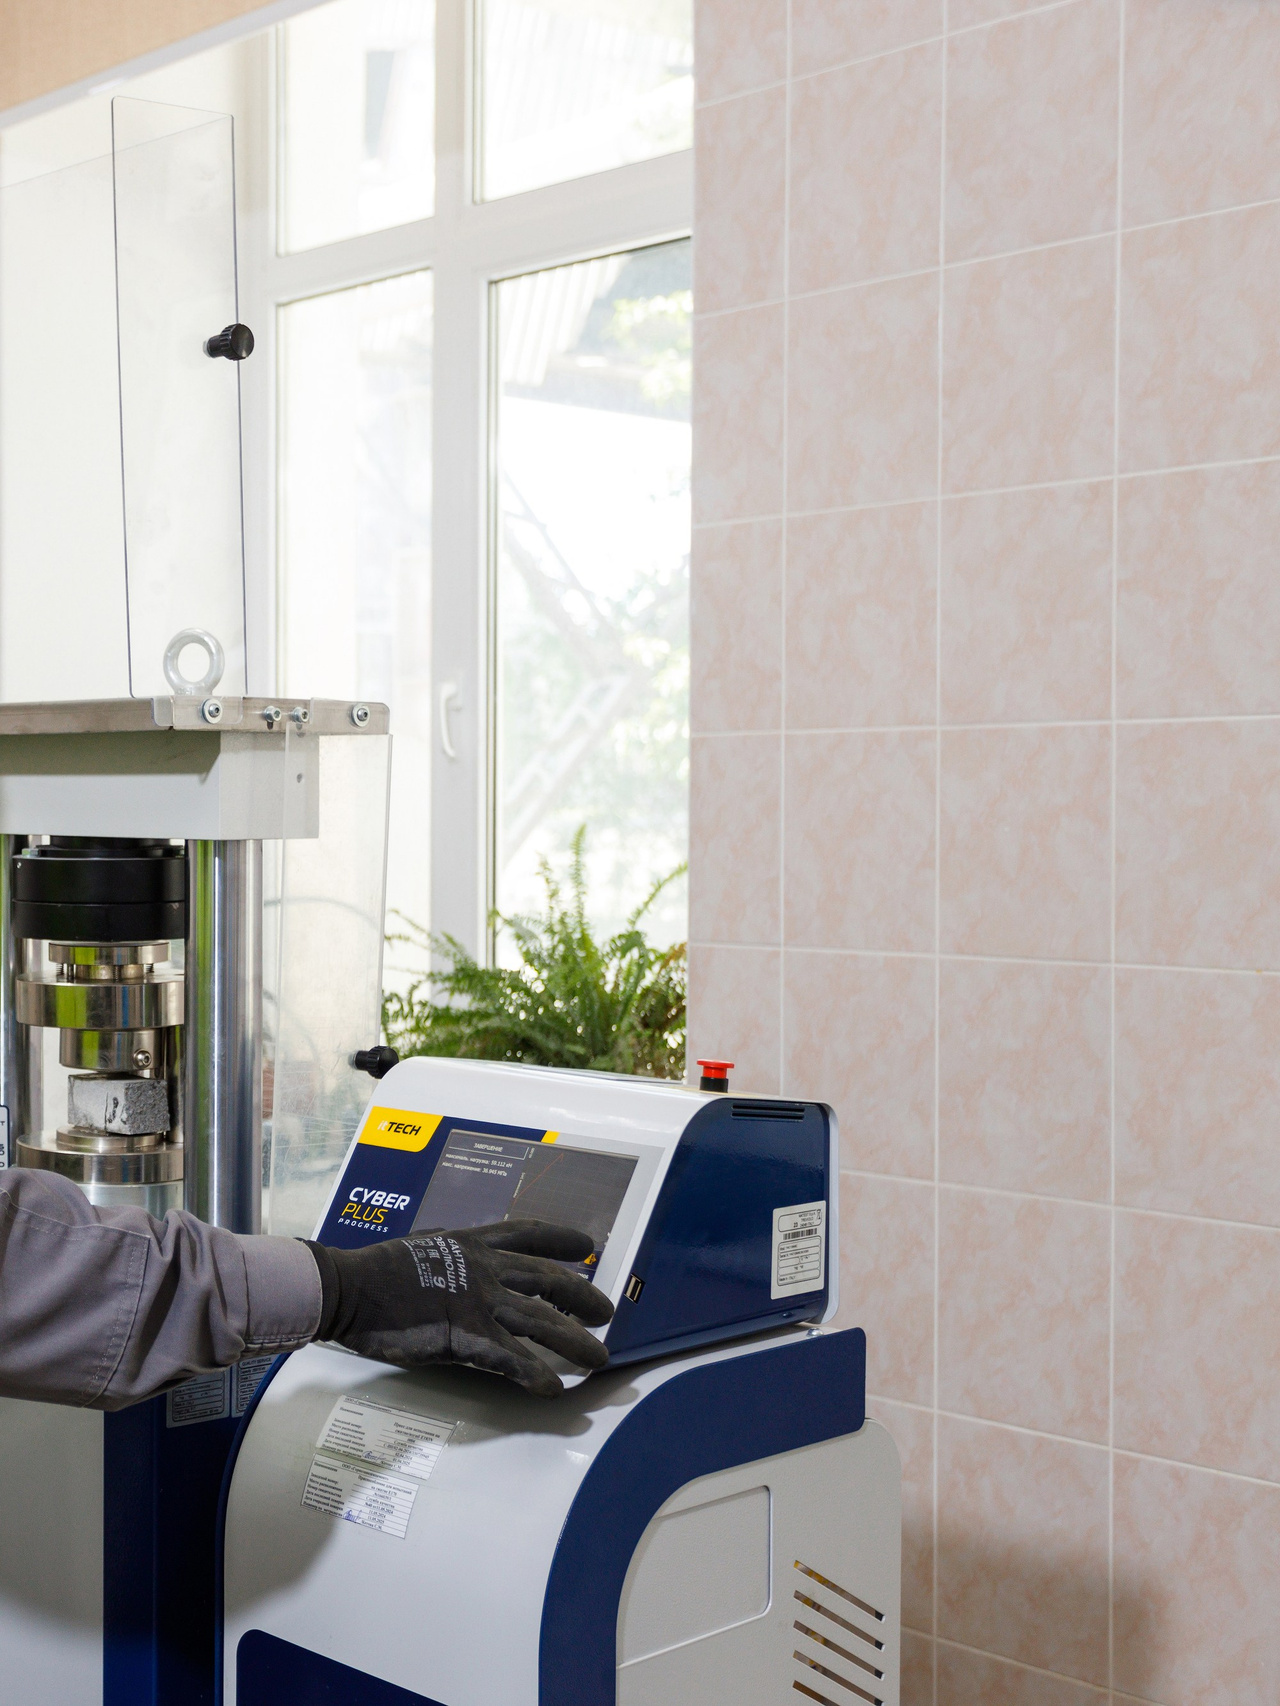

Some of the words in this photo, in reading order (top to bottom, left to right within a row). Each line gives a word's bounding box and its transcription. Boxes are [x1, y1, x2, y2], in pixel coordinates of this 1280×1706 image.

[349, 1186, 410, 1211] CYBER
[341, 1202, 389, 1224] PLUS
[338, 1218, 389, 1233] PROGRESS
[434, 1236, 457, 1294] ЭВОЛЮШН
